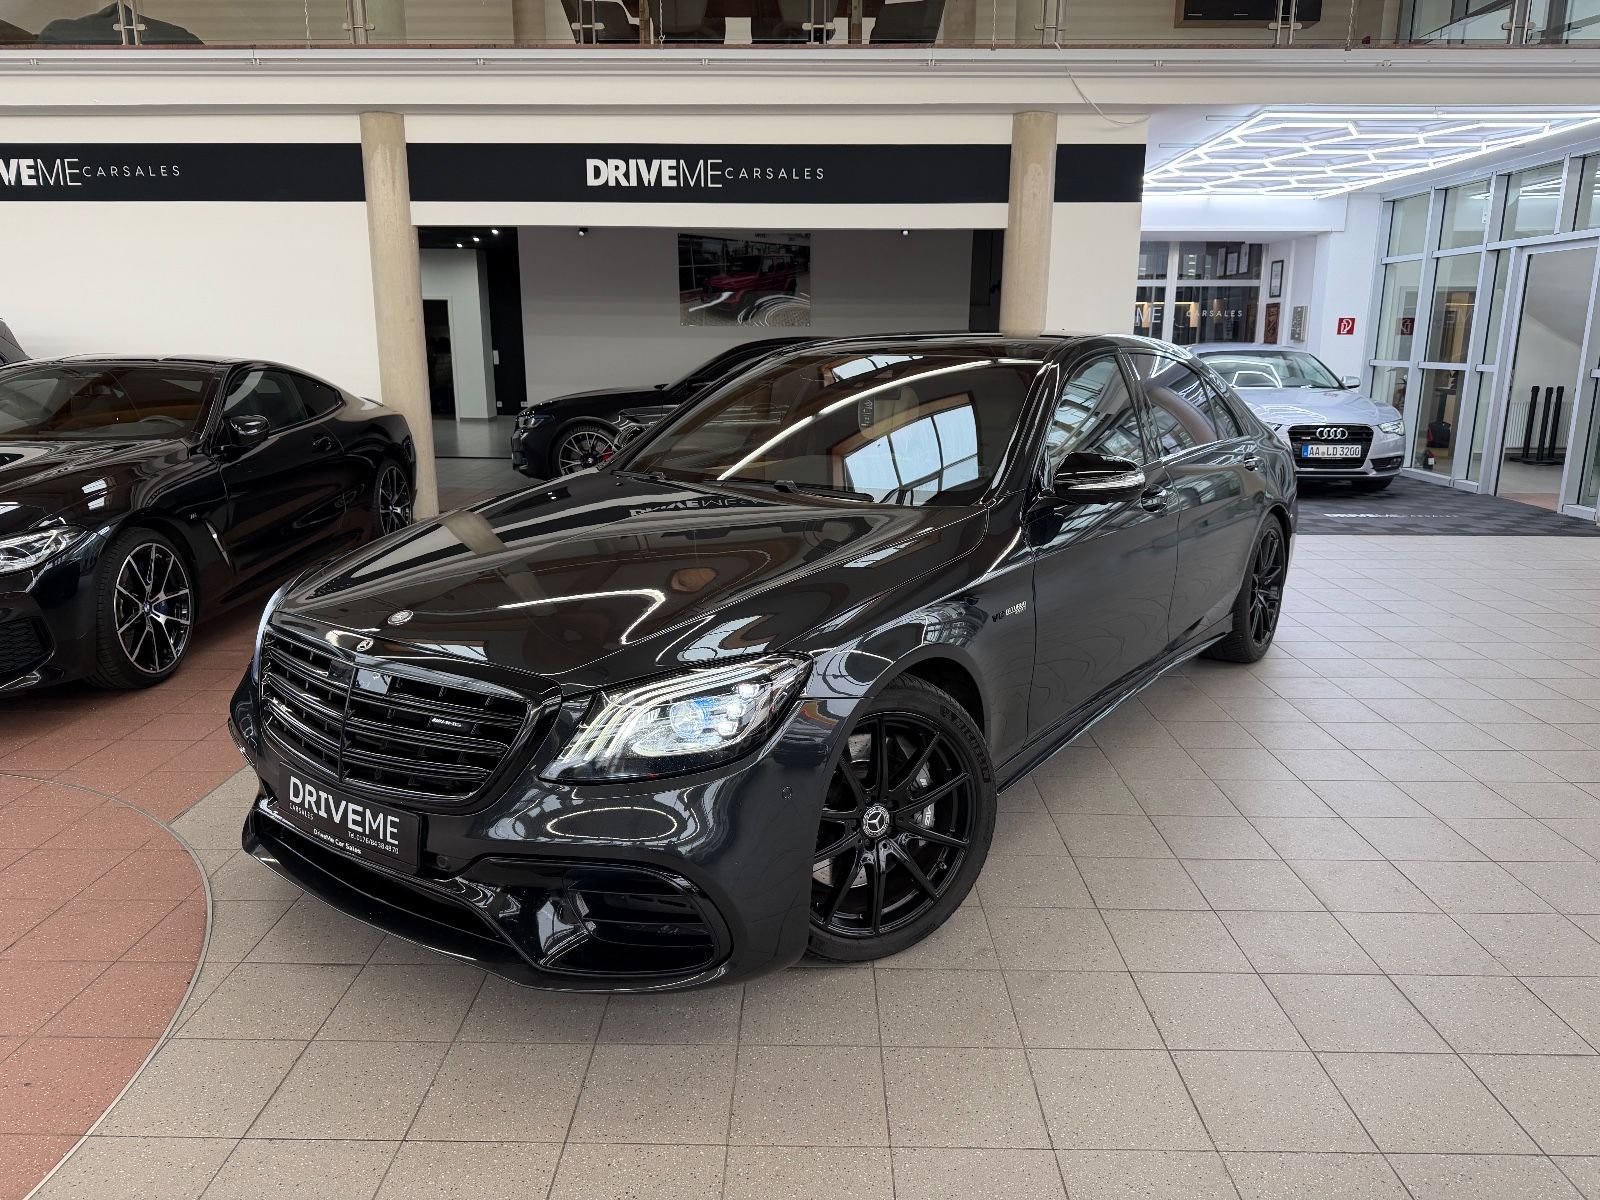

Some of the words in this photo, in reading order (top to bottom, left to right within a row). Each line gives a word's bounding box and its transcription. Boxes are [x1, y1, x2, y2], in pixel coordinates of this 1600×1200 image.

[82, 165, 181, 177] CARSALES
[586, 158, 723, 187] DRIVEME
[725, 167, 824, 180] CARSALES
[1309, 446, 1320, 457] AA
[1326, 446, 1338, 457] LD
[1340, 446, 1360, 457] 3200
[289, 775, 400, 845] DRIVEME
[289, 802, 314, 820] CARSALES
[345, 843, 362, 854] Sales
